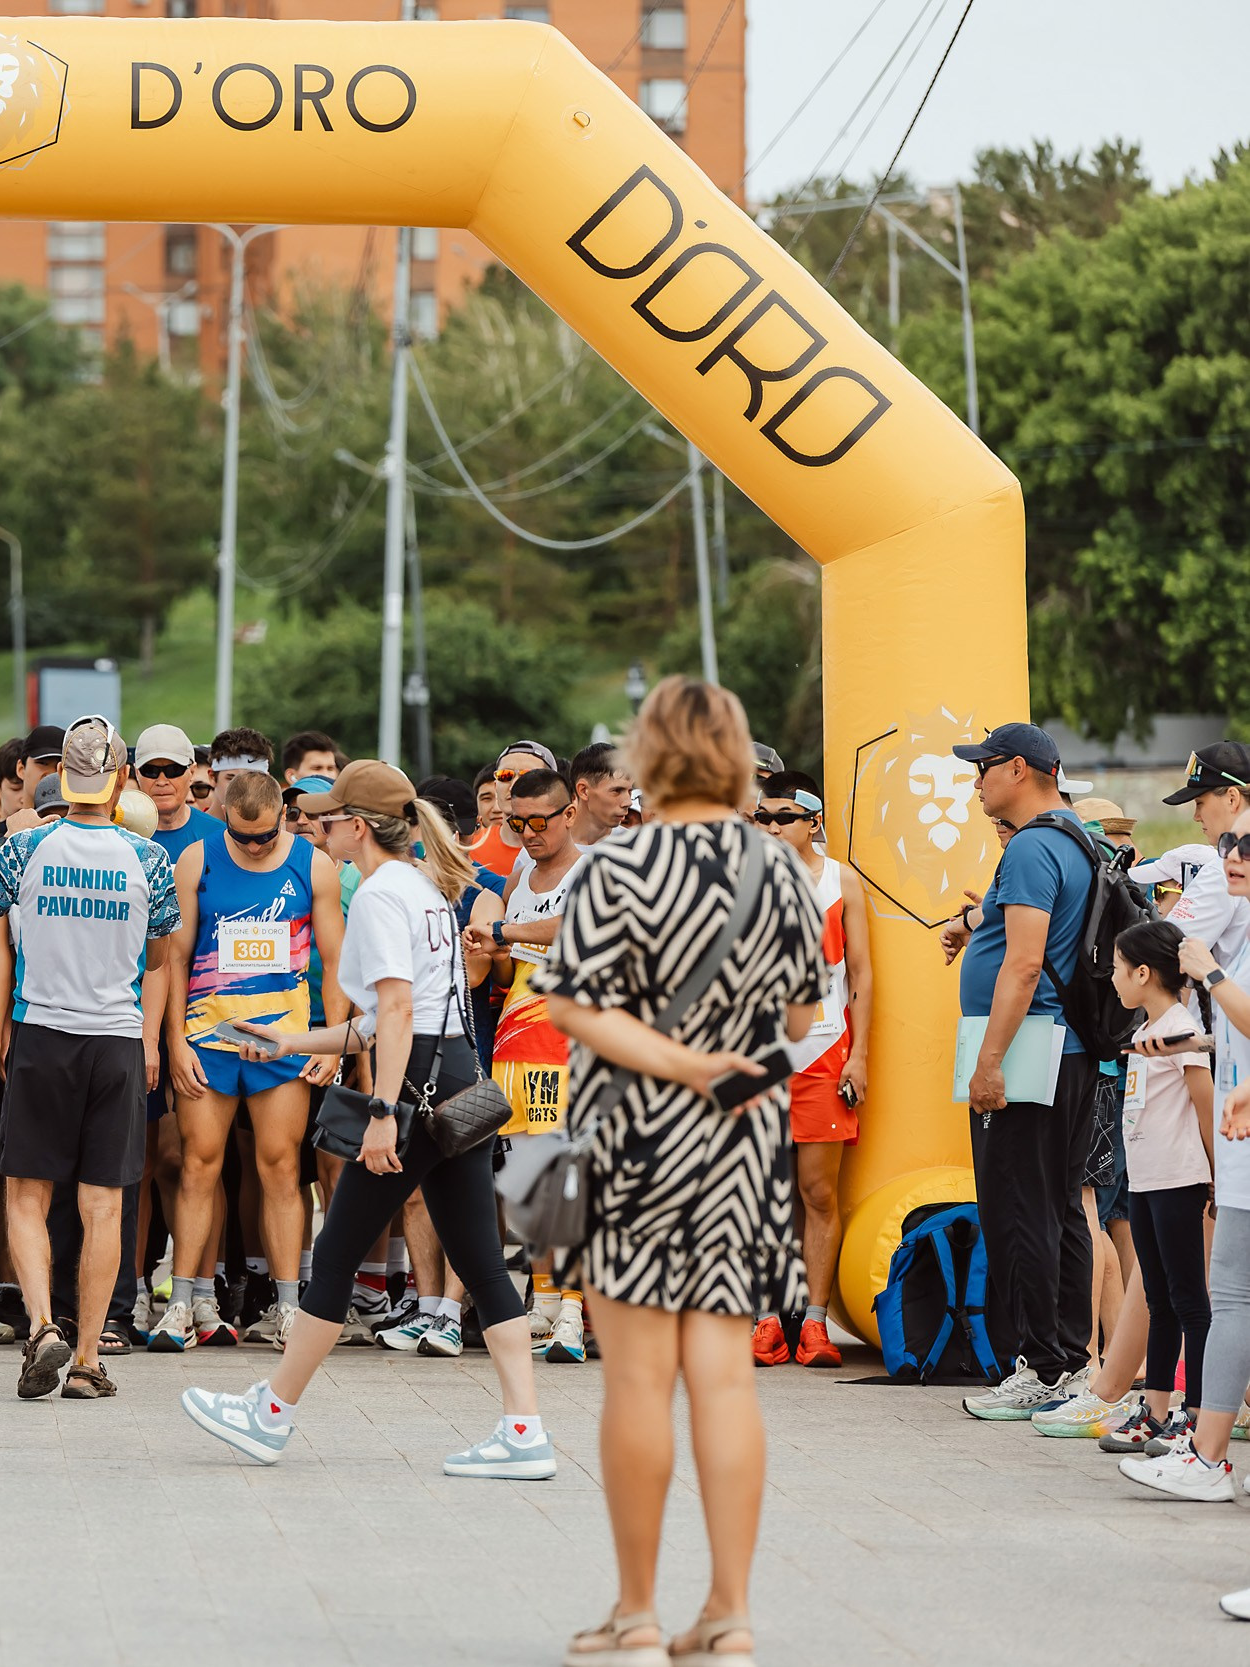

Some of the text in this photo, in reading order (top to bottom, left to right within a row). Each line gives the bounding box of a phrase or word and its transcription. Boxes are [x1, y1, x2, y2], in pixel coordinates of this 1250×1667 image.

[131, 61, 417, 133] D'ORO
[565, 164, 893, 468] D'ORO
[42, 865, 127, 892] RUNNING
[37, 895, 130, 921] PAVLODAR
[237, 942, 270, 959] 360
[523, 1071, 559, 1105] YM
